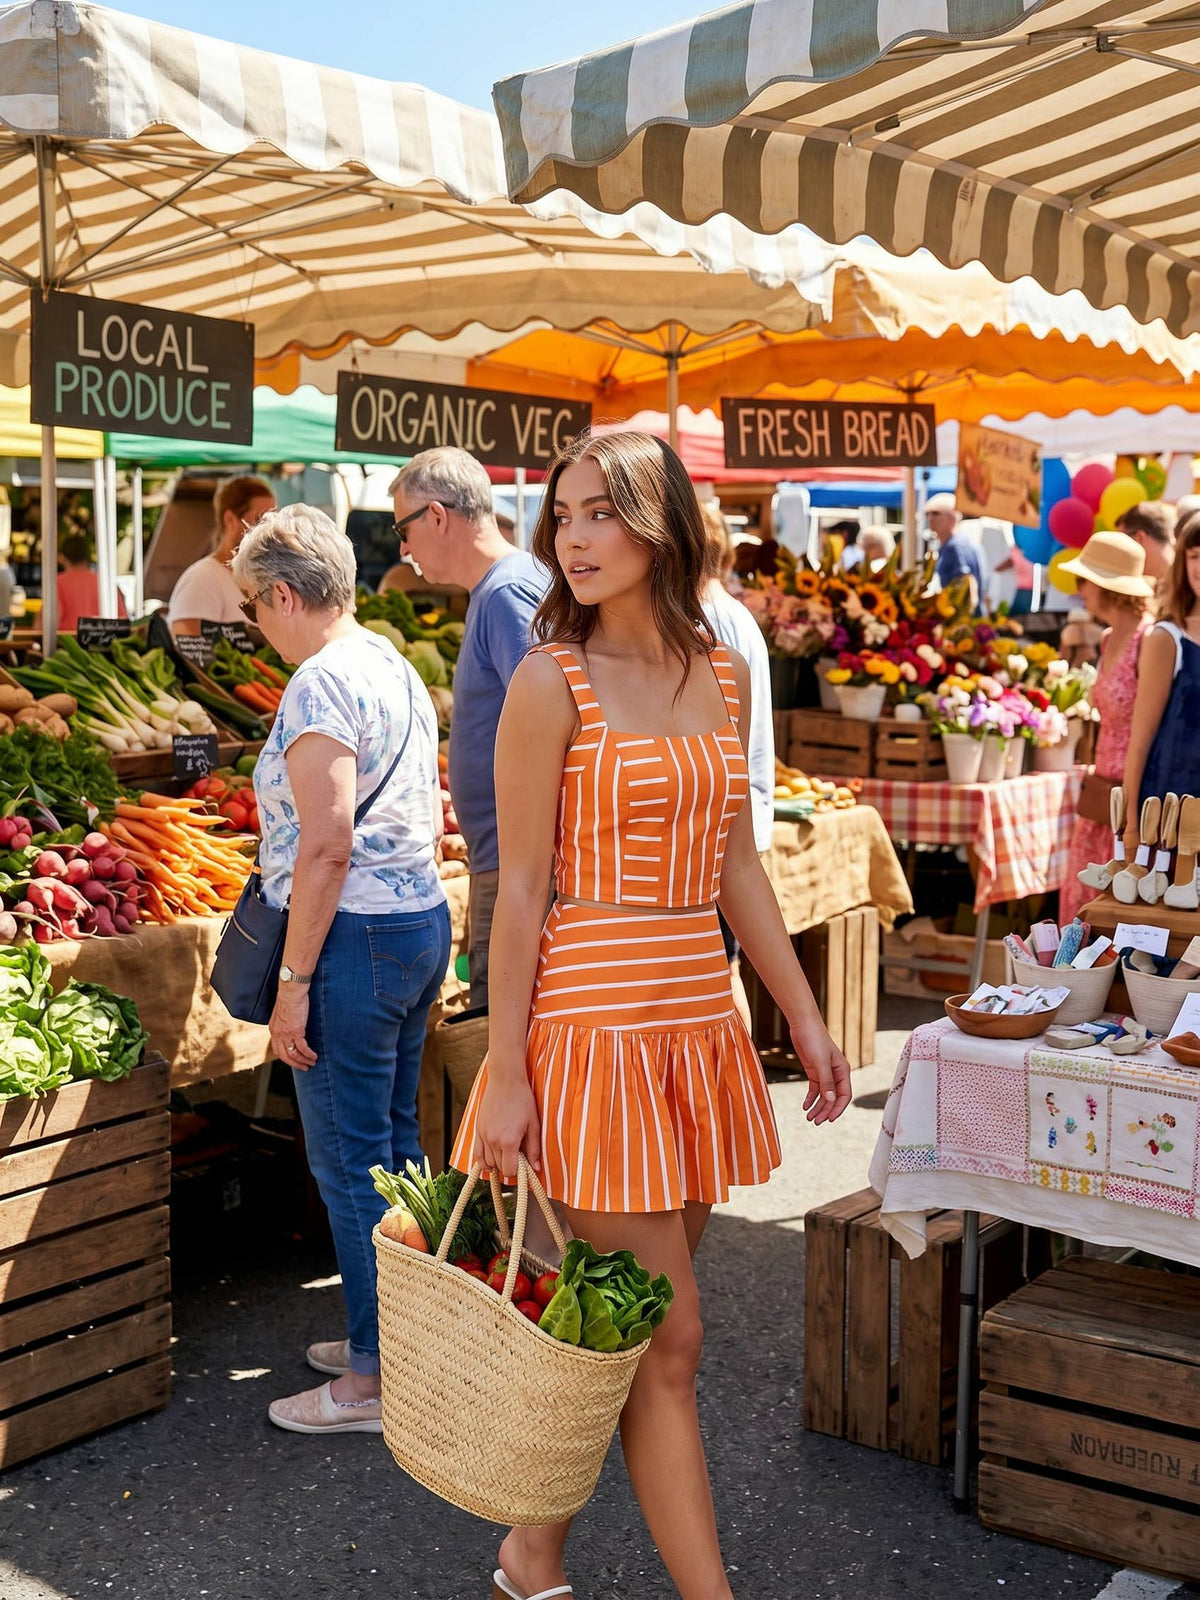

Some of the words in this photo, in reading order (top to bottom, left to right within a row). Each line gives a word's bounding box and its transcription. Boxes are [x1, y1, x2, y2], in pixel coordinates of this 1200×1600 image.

[77, 309, 209, 373] LOCAL
[55, 361, 232, 430] PRODUCE
[350, 385, 497, 451] ORGANIC
[511, 403, 576, 457] VEG
[738, 407, 831, 458] FRESH
[843, 409, 930, 458] BREAD
